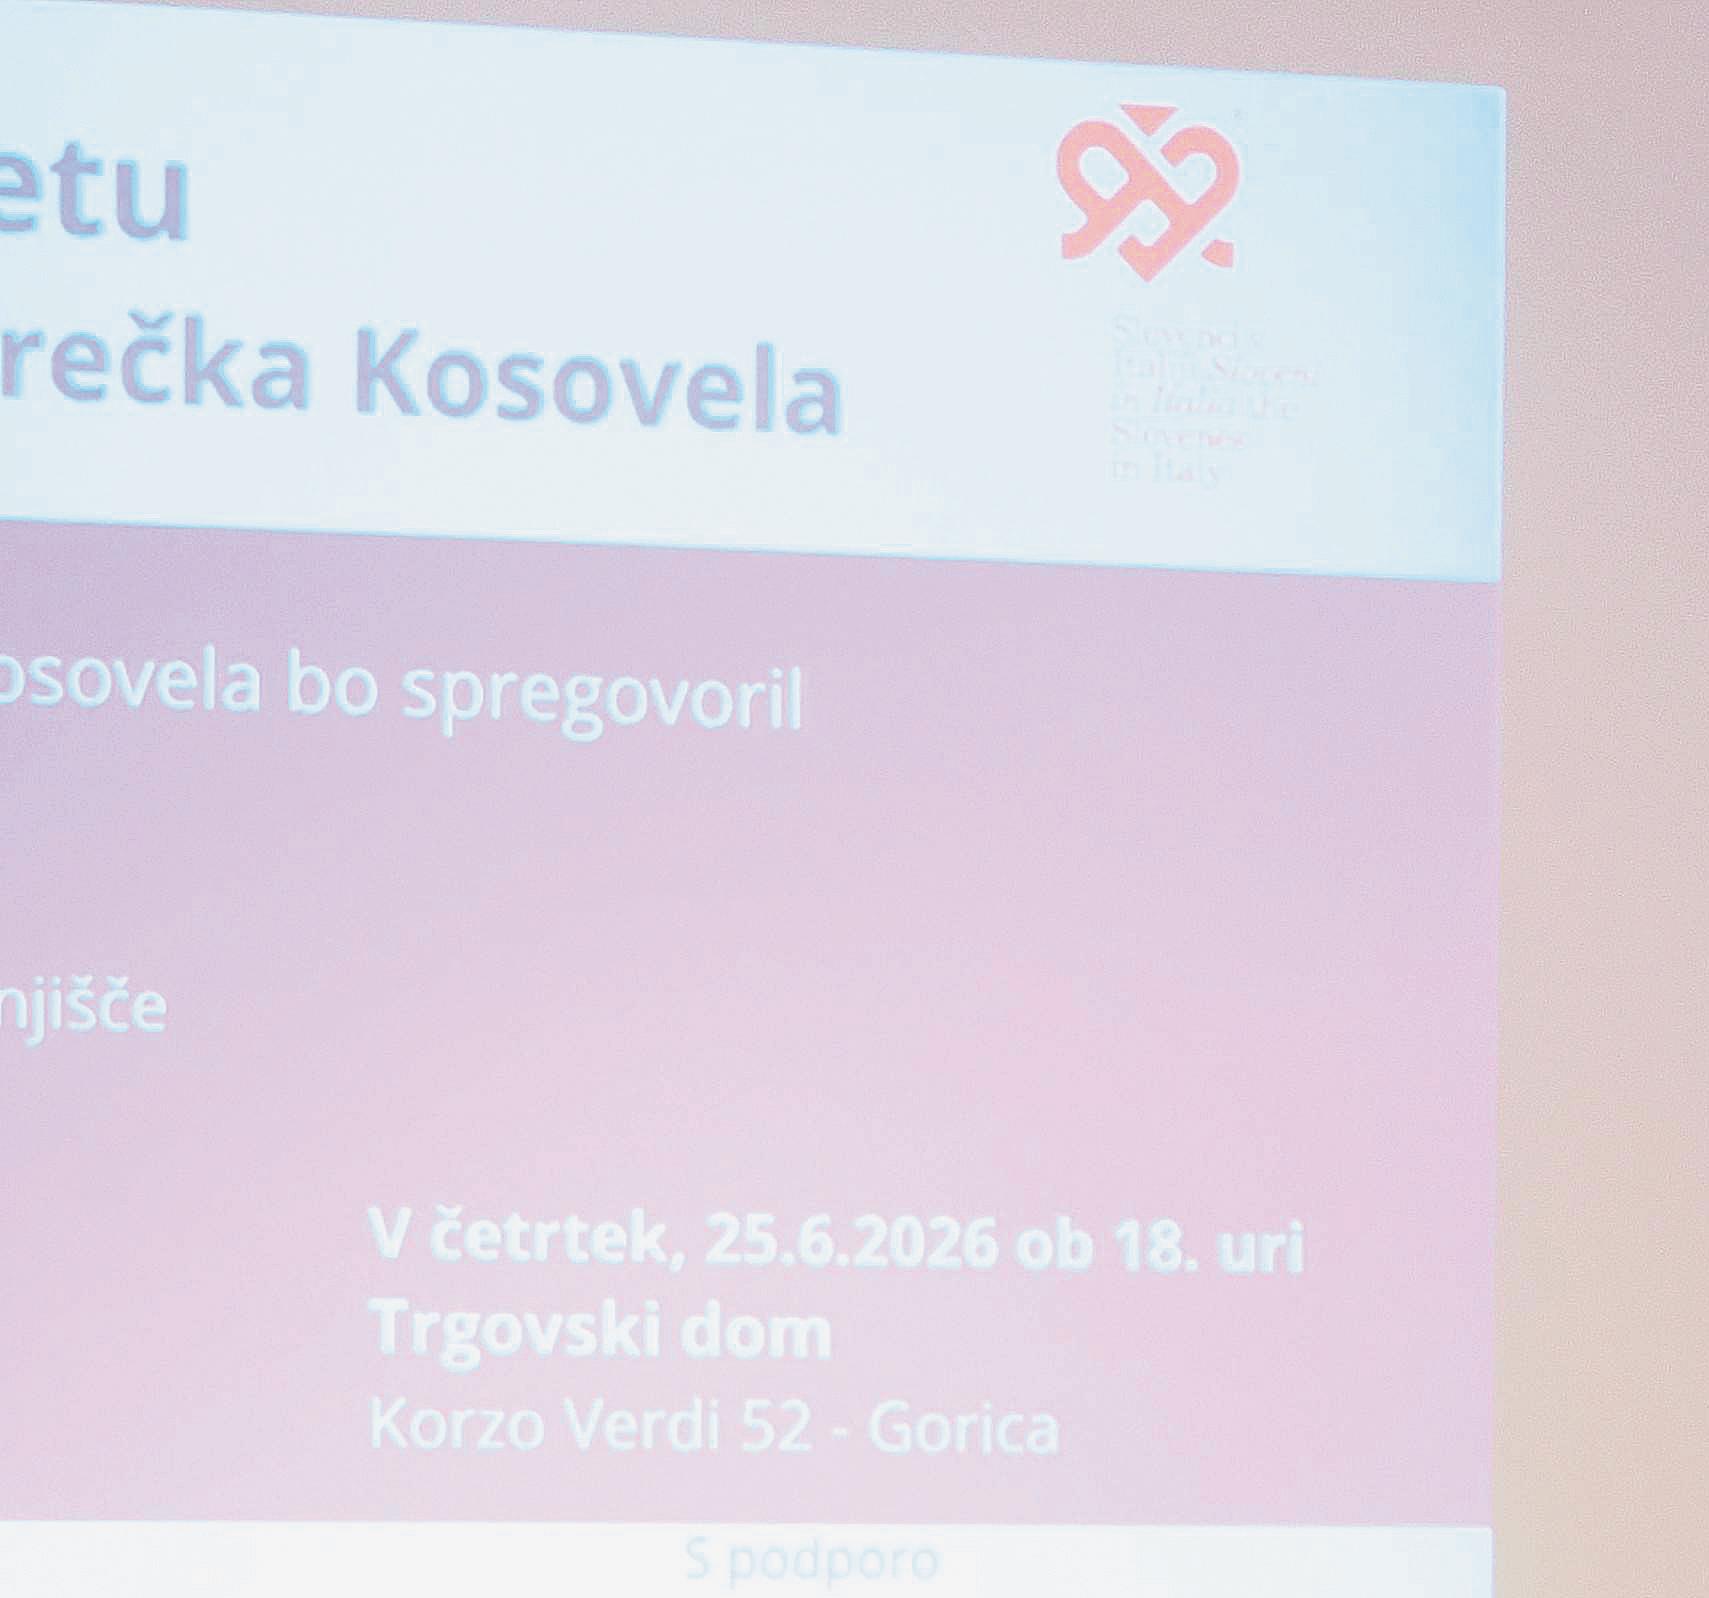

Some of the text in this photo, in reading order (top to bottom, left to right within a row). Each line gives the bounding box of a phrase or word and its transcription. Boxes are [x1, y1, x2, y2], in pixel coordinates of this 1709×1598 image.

[0, 142, 190, 241] etu
[356, 327, 842, 434] Kosovela
[288, 648, 379, 716] bo
[402, 666, 803, 742] spregovoril
[367, 1204, 1305, 1275] V četrtek, 25.6.2026 ob 18. uri
[367, 1297, 832, 1373] Trgovski dom
[369, 1396, 546, 1451] Korzo
[562, 1396, 720, 1453] Verdi
[741, 1398, 812, 1453] 52
[869, 1399, 1060, 1455] Gorica
[686, 1534, 940, 1592] S podporo
